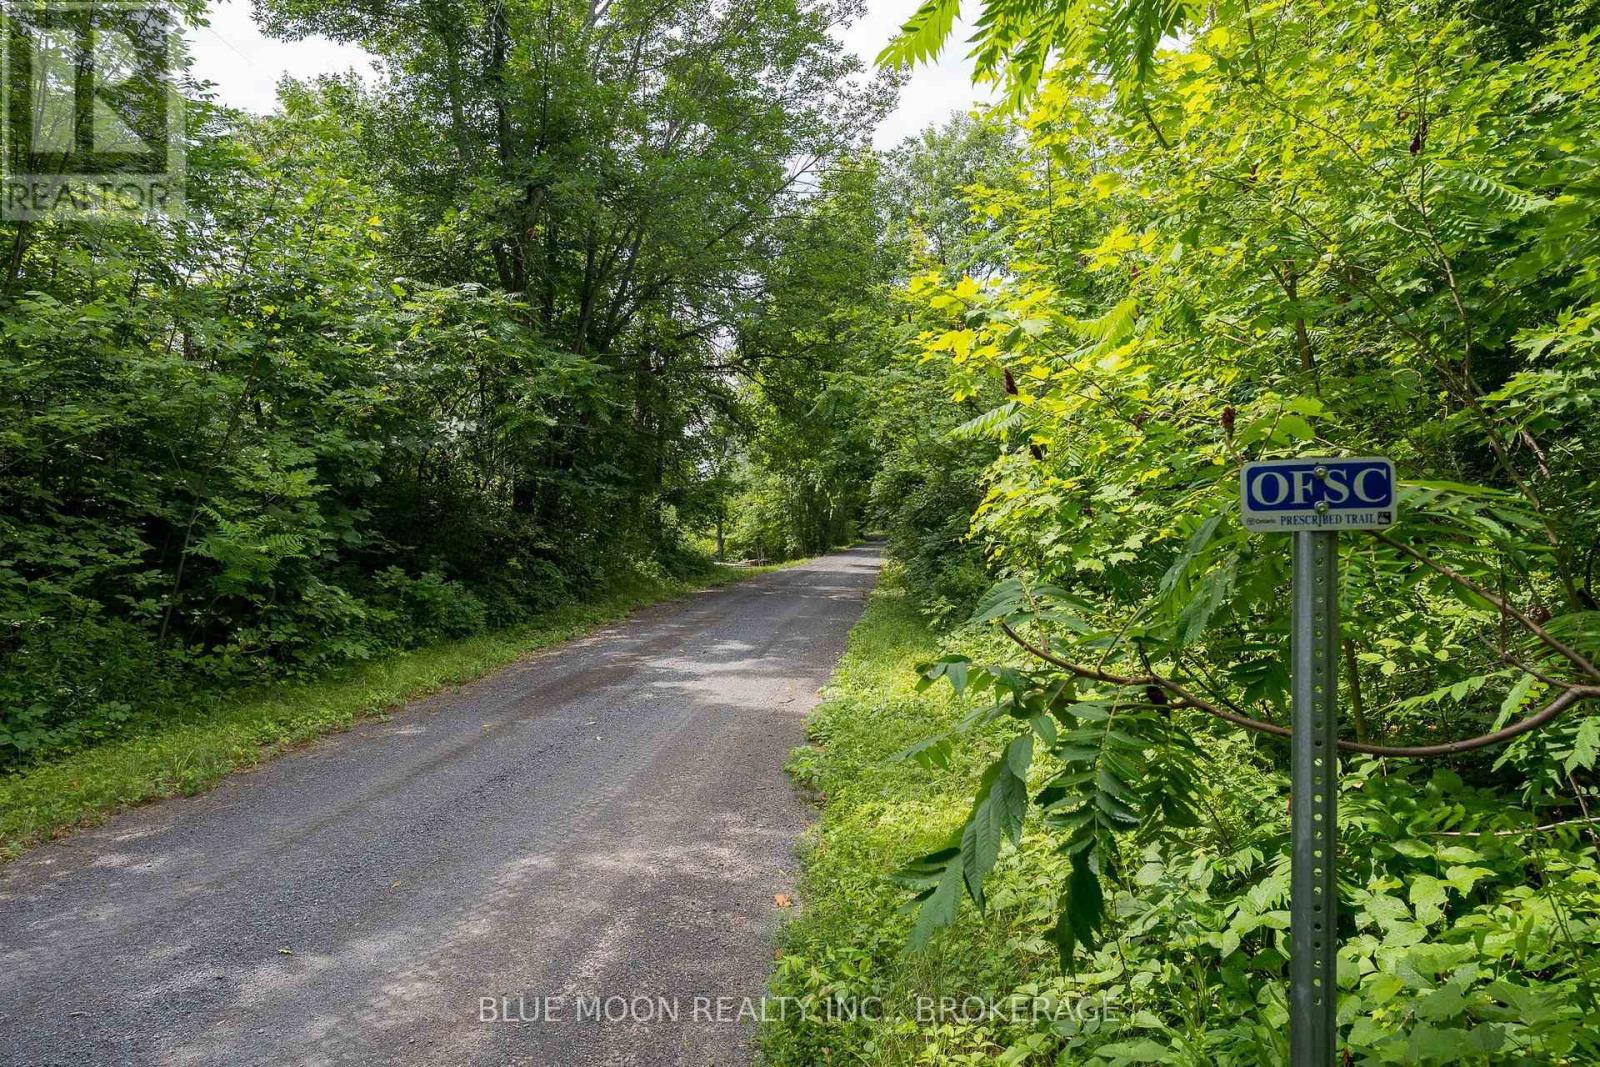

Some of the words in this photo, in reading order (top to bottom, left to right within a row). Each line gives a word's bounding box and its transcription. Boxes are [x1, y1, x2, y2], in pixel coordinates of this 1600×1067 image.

[1251, 467, 1388, 506] OFSC
[1280, 513, 1343, 527] PRESCRIBED
[1345, 512, 1376, 525] TRAIL
